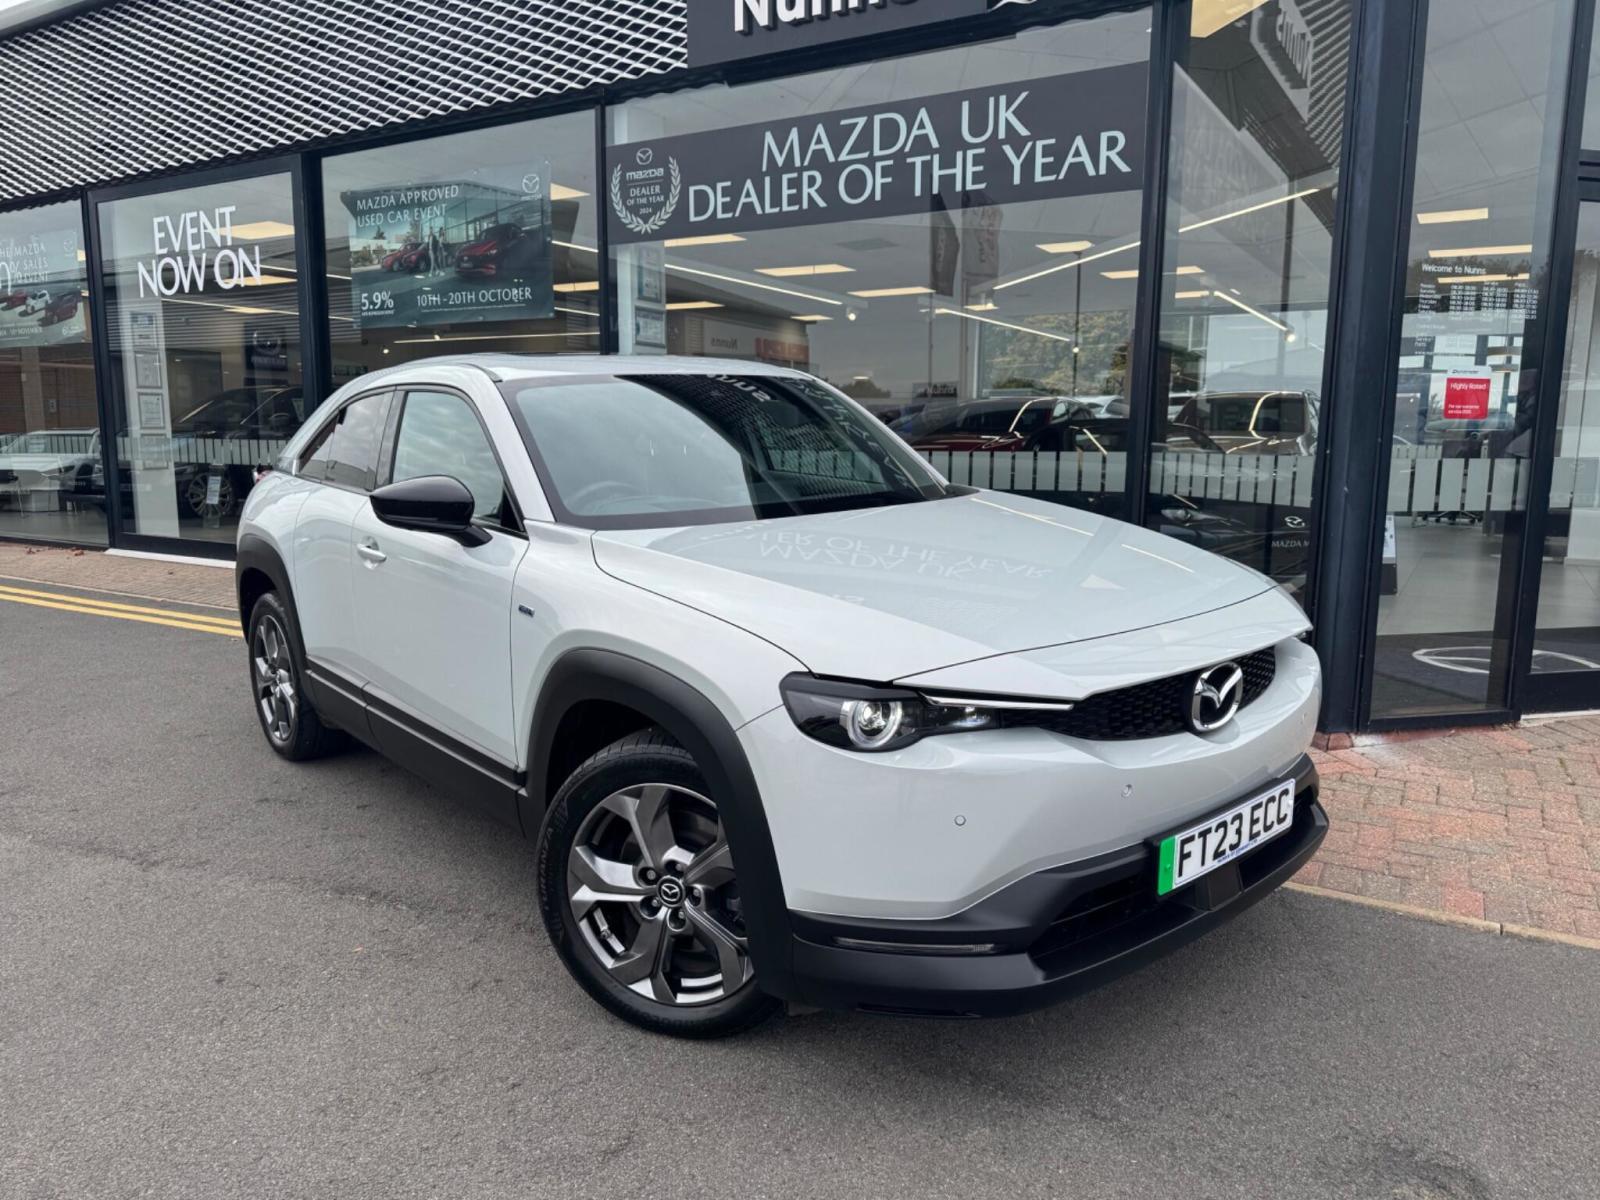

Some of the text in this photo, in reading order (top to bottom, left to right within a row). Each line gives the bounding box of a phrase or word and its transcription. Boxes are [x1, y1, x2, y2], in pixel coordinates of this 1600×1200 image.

[762, 91, 1031, 172] MAZDA UK
[689, 130, 1132, 222] DEALER OF THE YEAR
[356, 185, 459, 211] MAZDA APPROVED
[626, 194, 665, 206] OF THE YEAR
[629, 184, 661, 197] DEALER
[357, 203, 447, 227] USED CAR EVENT
[152, 205, 236, 255] EVENT
[137, 245, 261, 298] NOW ON
[1421, 264, 1487, 274] Welcome to Nunns
[361, 291, 394, 310] 5.9%
[416, 294, 441, 308] 10TH
[478, 287, 532, 303] OCTOBER
[1450, 382, 1468, 391] Highly
[1271, 540, 1302, 548] MAZDA
[1178, 812, 1244, 878] FT23
[1249, 788, 1290, 841] ECC
